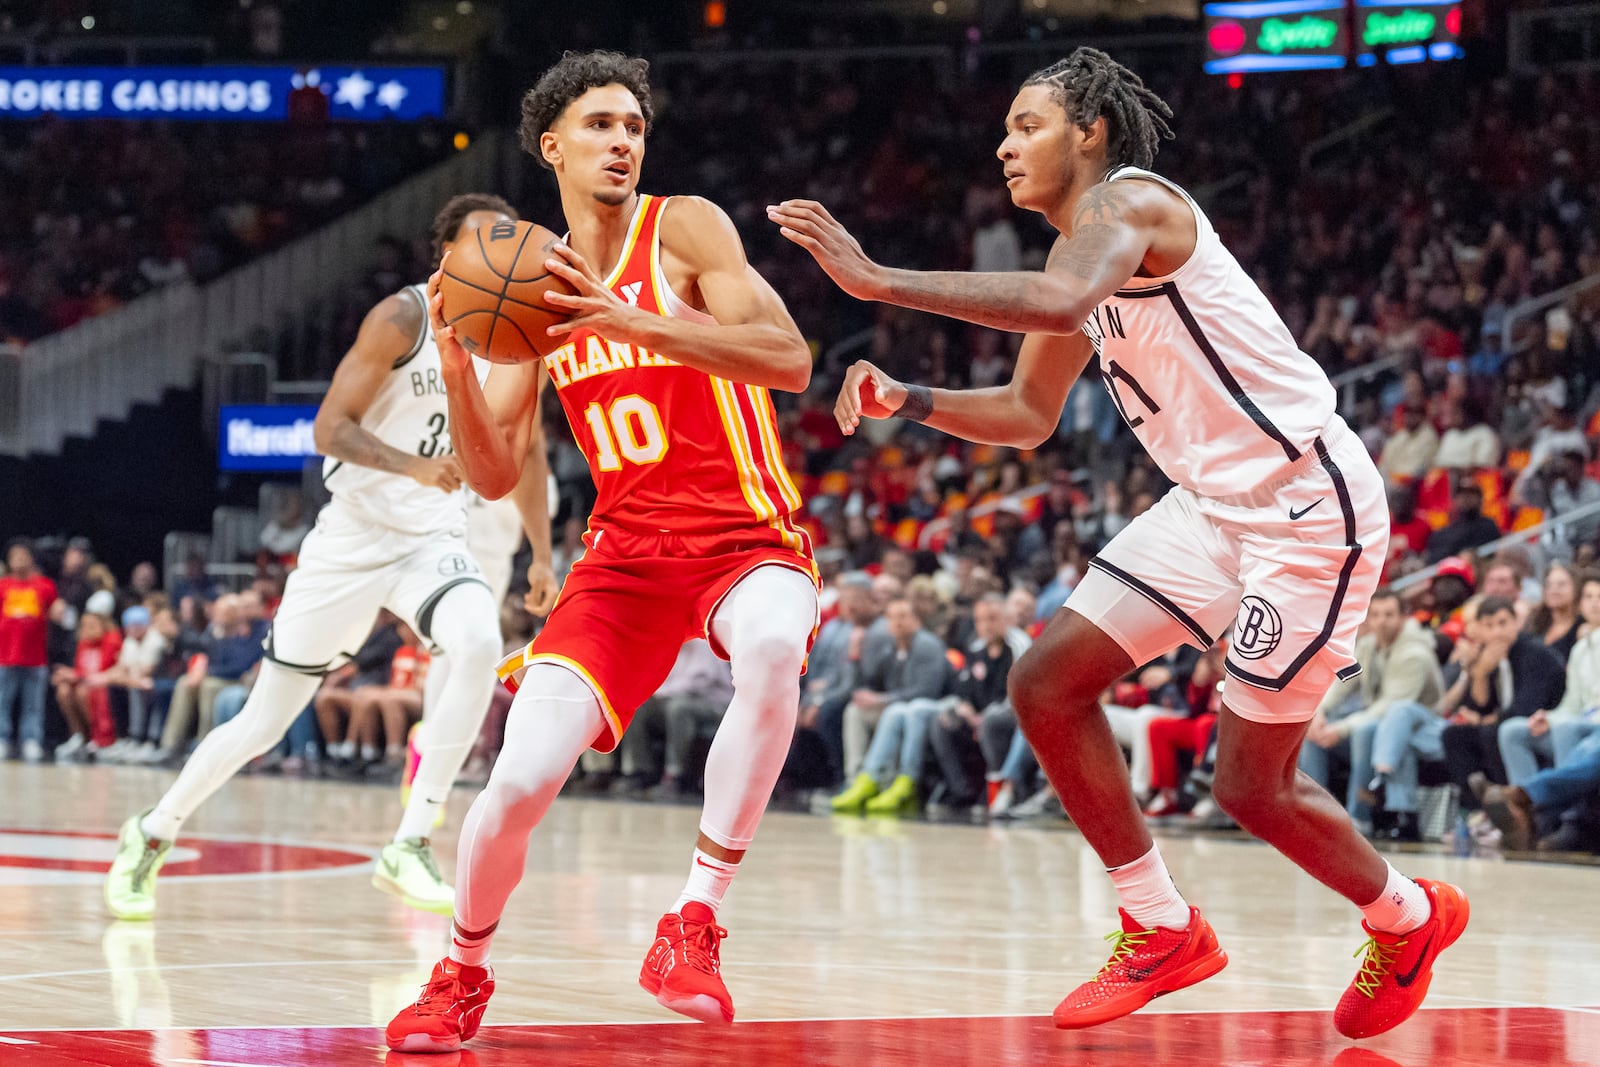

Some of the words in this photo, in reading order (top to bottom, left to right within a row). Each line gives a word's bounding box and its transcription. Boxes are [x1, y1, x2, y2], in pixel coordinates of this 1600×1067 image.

[111, 79, 271, 112] CASINOS
[584, 394, 669, 472] 10
[1240, 605, 1265, 650] B
